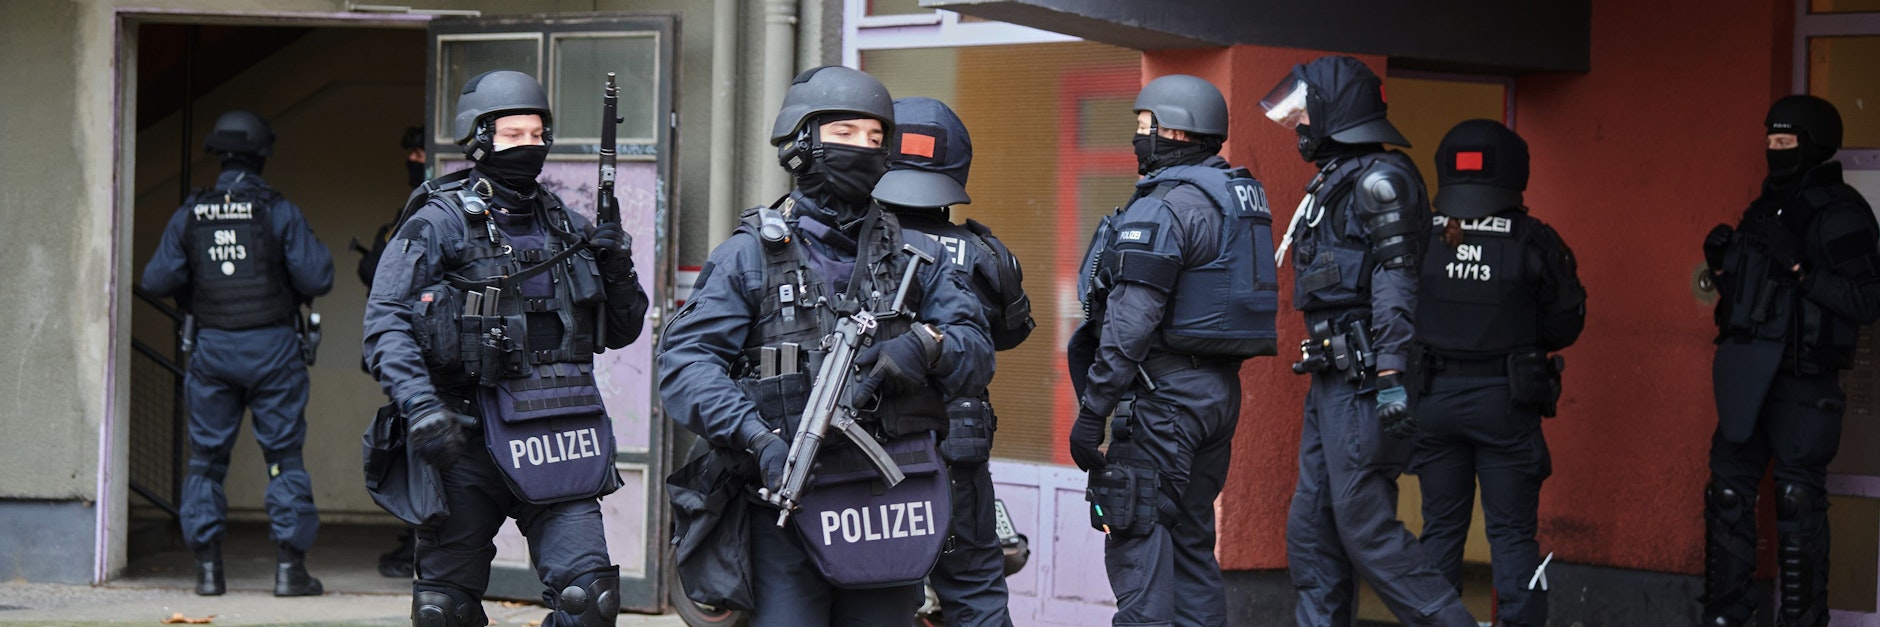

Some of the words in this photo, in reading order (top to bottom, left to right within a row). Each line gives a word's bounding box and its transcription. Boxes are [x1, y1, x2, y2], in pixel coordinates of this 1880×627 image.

[194, 202, 253, 221] POLIZEI
[214, 229, 237, 246] SN
[1120, 231, 1142, 240] POLIZEI
[207, 244, 247, 262] 11/13
[1456, 244, 1482, 261] SN
[1445, 262, 1491, 281] 11/13
[509, 427, 601, 469] POLIZEI
[820, 500, 935, 546] POLIZEI
